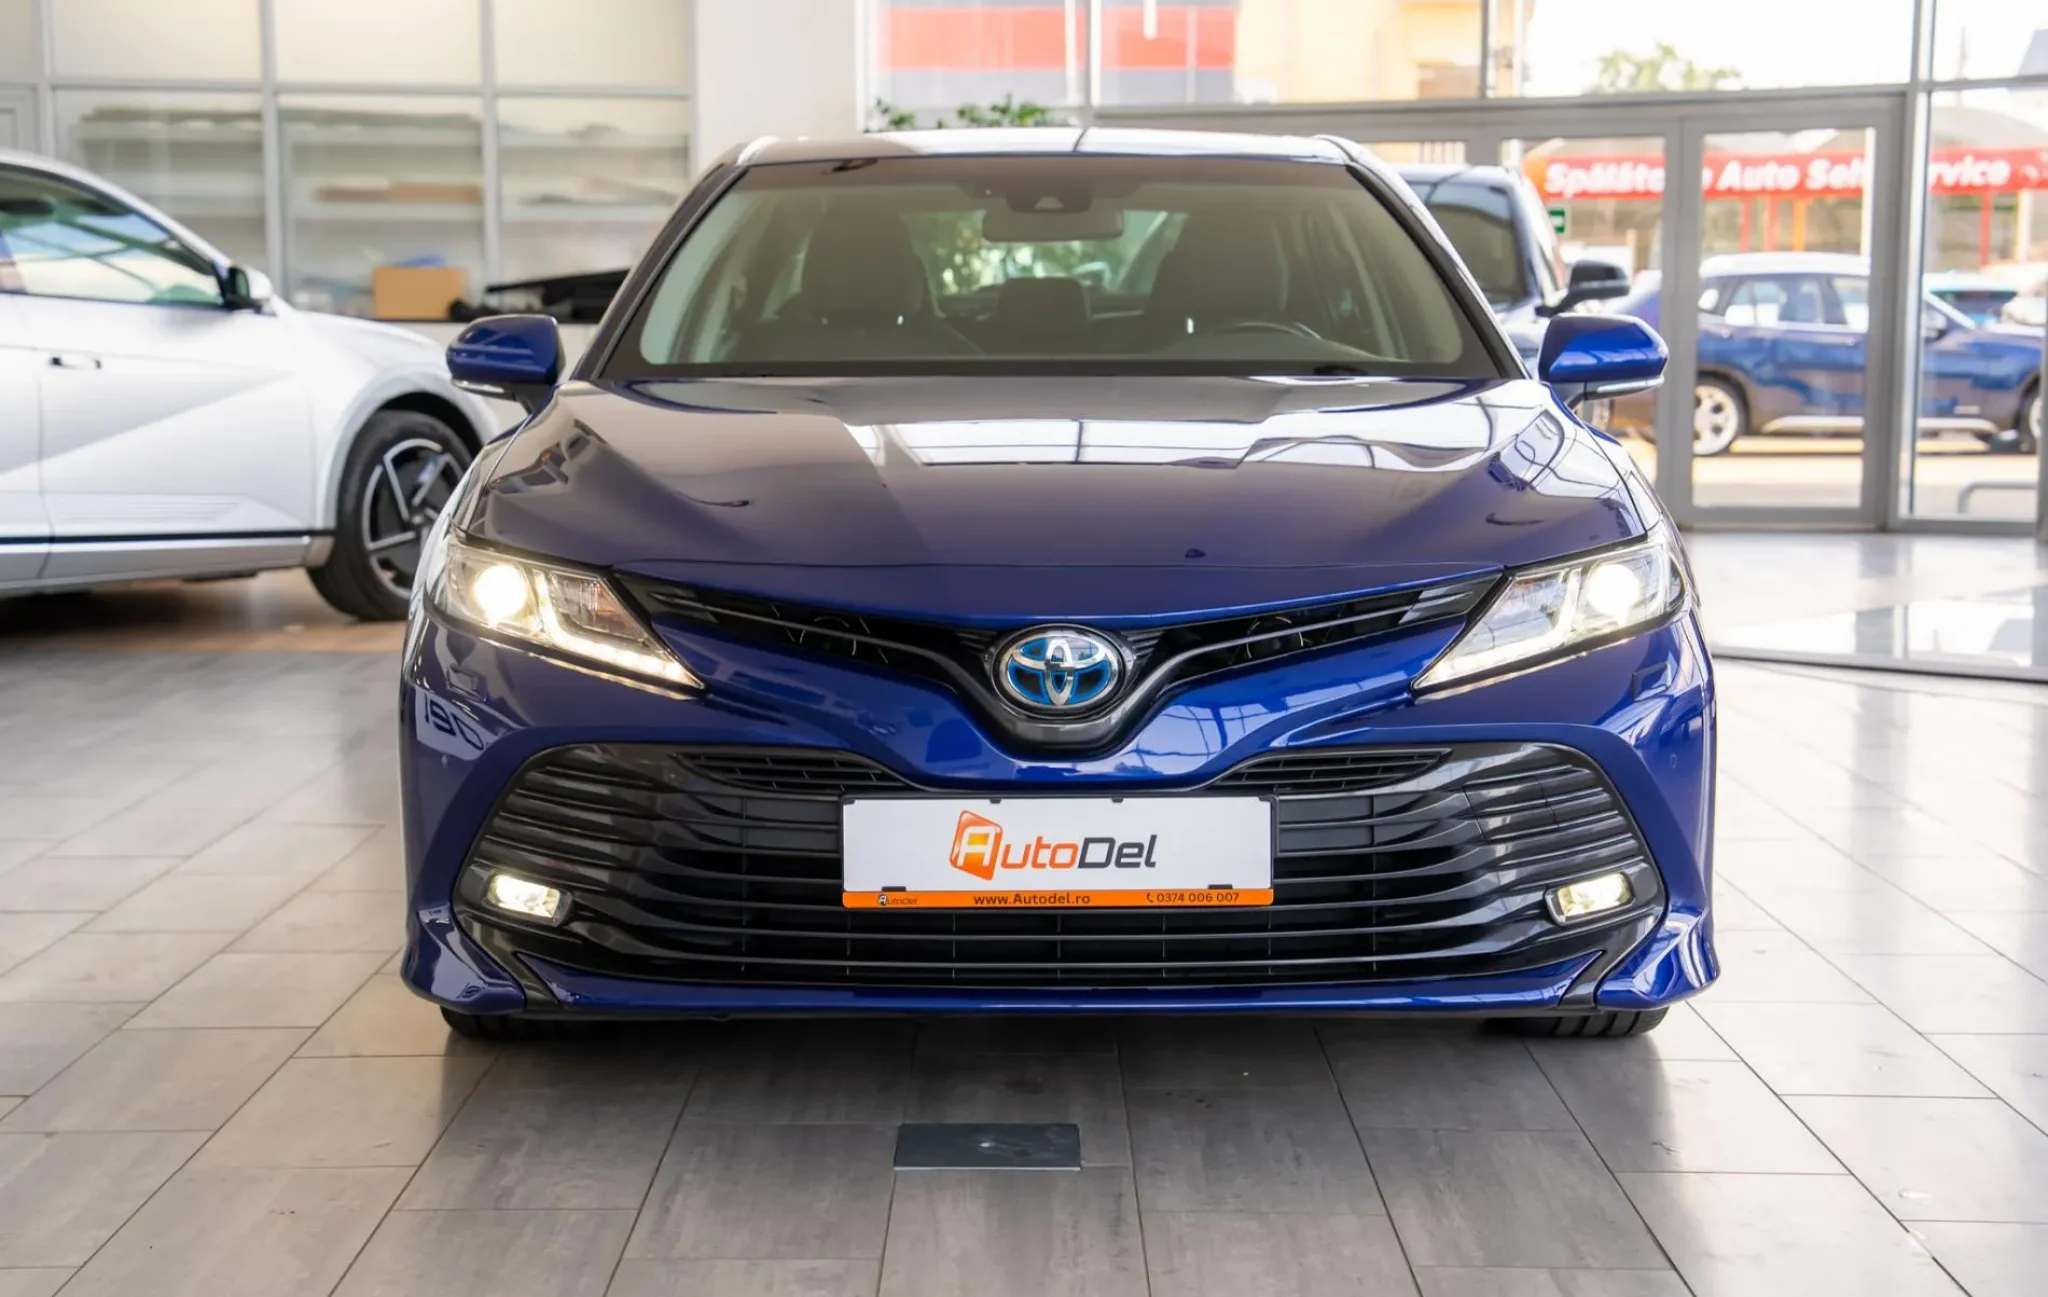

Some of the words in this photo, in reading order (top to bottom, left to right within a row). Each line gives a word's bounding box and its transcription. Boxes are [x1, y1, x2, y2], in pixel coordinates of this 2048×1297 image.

[1716, 159, 1800, 191] Auto
[954, 824, 1158, 869] AutoDel
[973, 891, 1091, 905] www.Autodel.ro
[1156, 892, 1185, 903] 0374
[1188, 892, 1213, 903] 006
[1216, 892, 1240, 902] 007
